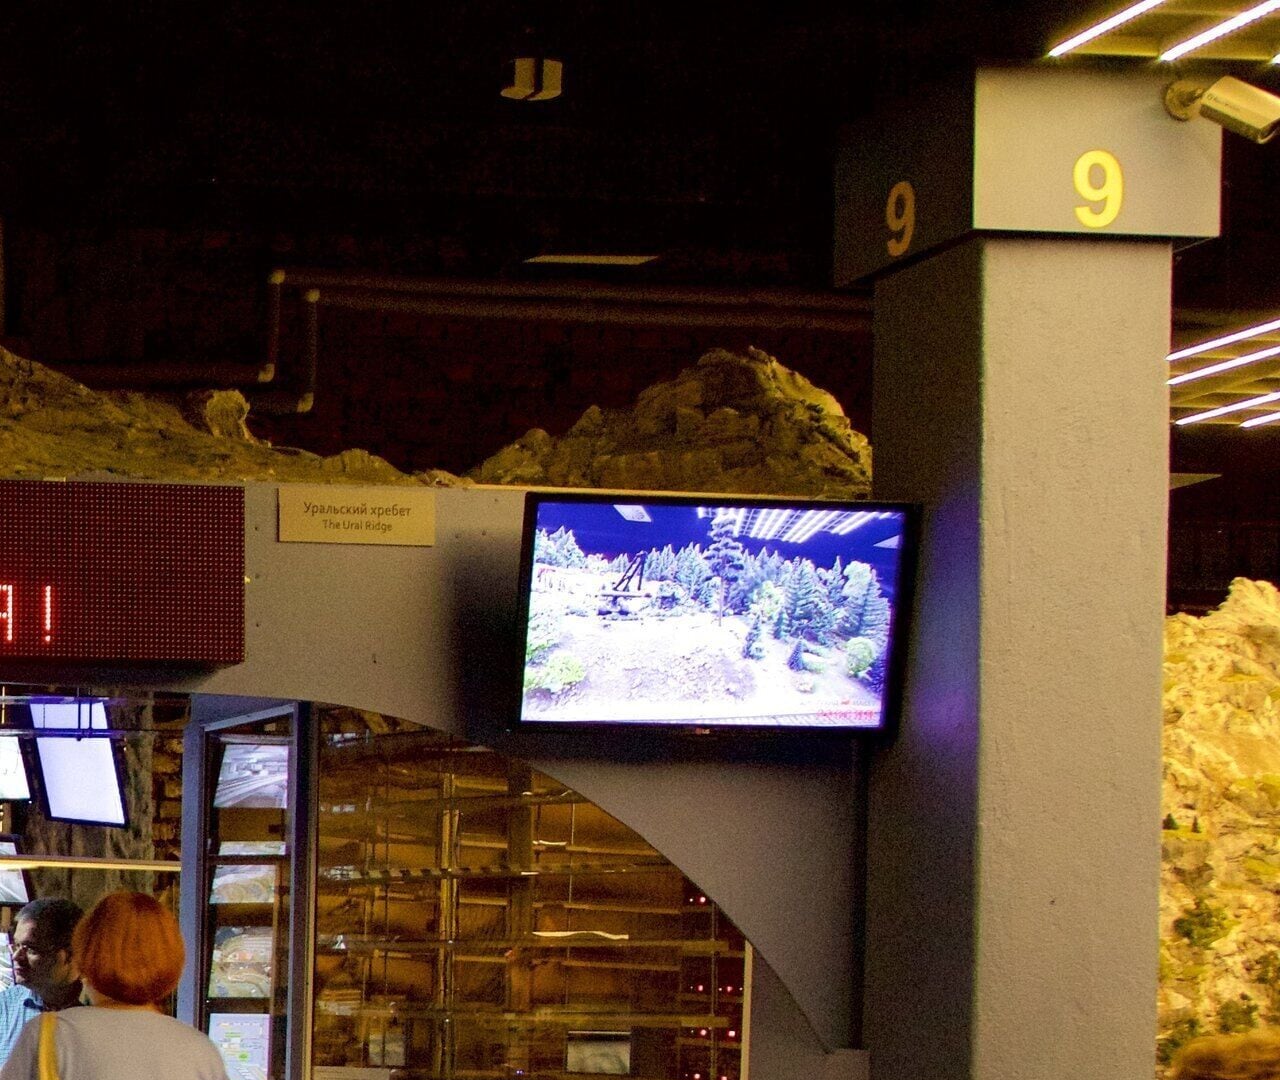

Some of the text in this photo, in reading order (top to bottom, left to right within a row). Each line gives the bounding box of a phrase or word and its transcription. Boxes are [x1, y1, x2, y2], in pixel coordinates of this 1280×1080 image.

[1072, 149, 1125, 229] 9
[885, 181, 916, 257] 9
[303, 501, 412, 518] Уральский хребет
[322, 518, 392, 533] The Ural Ridge
